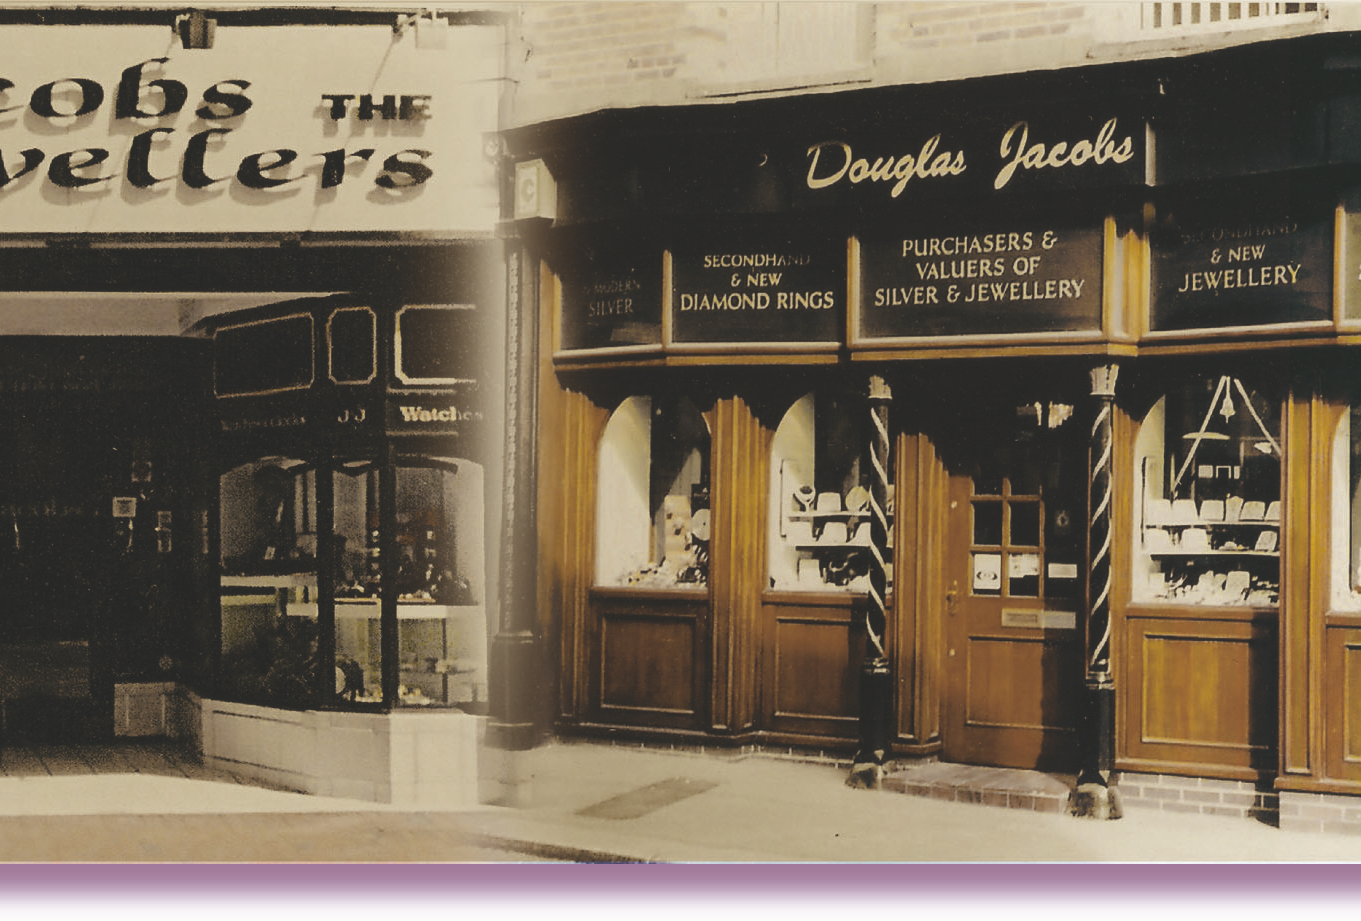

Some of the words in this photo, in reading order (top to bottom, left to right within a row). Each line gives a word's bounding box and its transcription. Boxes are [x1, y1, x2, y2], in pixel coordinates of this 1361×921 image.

[322, 94, 432, 119] THE
[807, 133, 967, 198] Douglas
[994, 117, 1134, 190] Jacobs
[902, 232, 1033, 257] PURCHASERS
[1041, 230, 1058, 249] &
[1210, 248, 1222, 264] &
[1228, 244, 1266, 263] NEW
[731, 273, 742, 287] &
[747, 272, 783, 287] NEW
[916, 258, 1005, 280] VALUERS
[1013, 256, 1041, 276] OF
[1178, 263, 1302, 292] JEWELLERY
[681, 292, 770, 311] DIAMOND
[777, 291, 834, 309] RINGS
[875, 286, 939, 307] SILVER
[947, 284, 961, 303] &
[965, 279, 1085, 302] JEWELLERY
